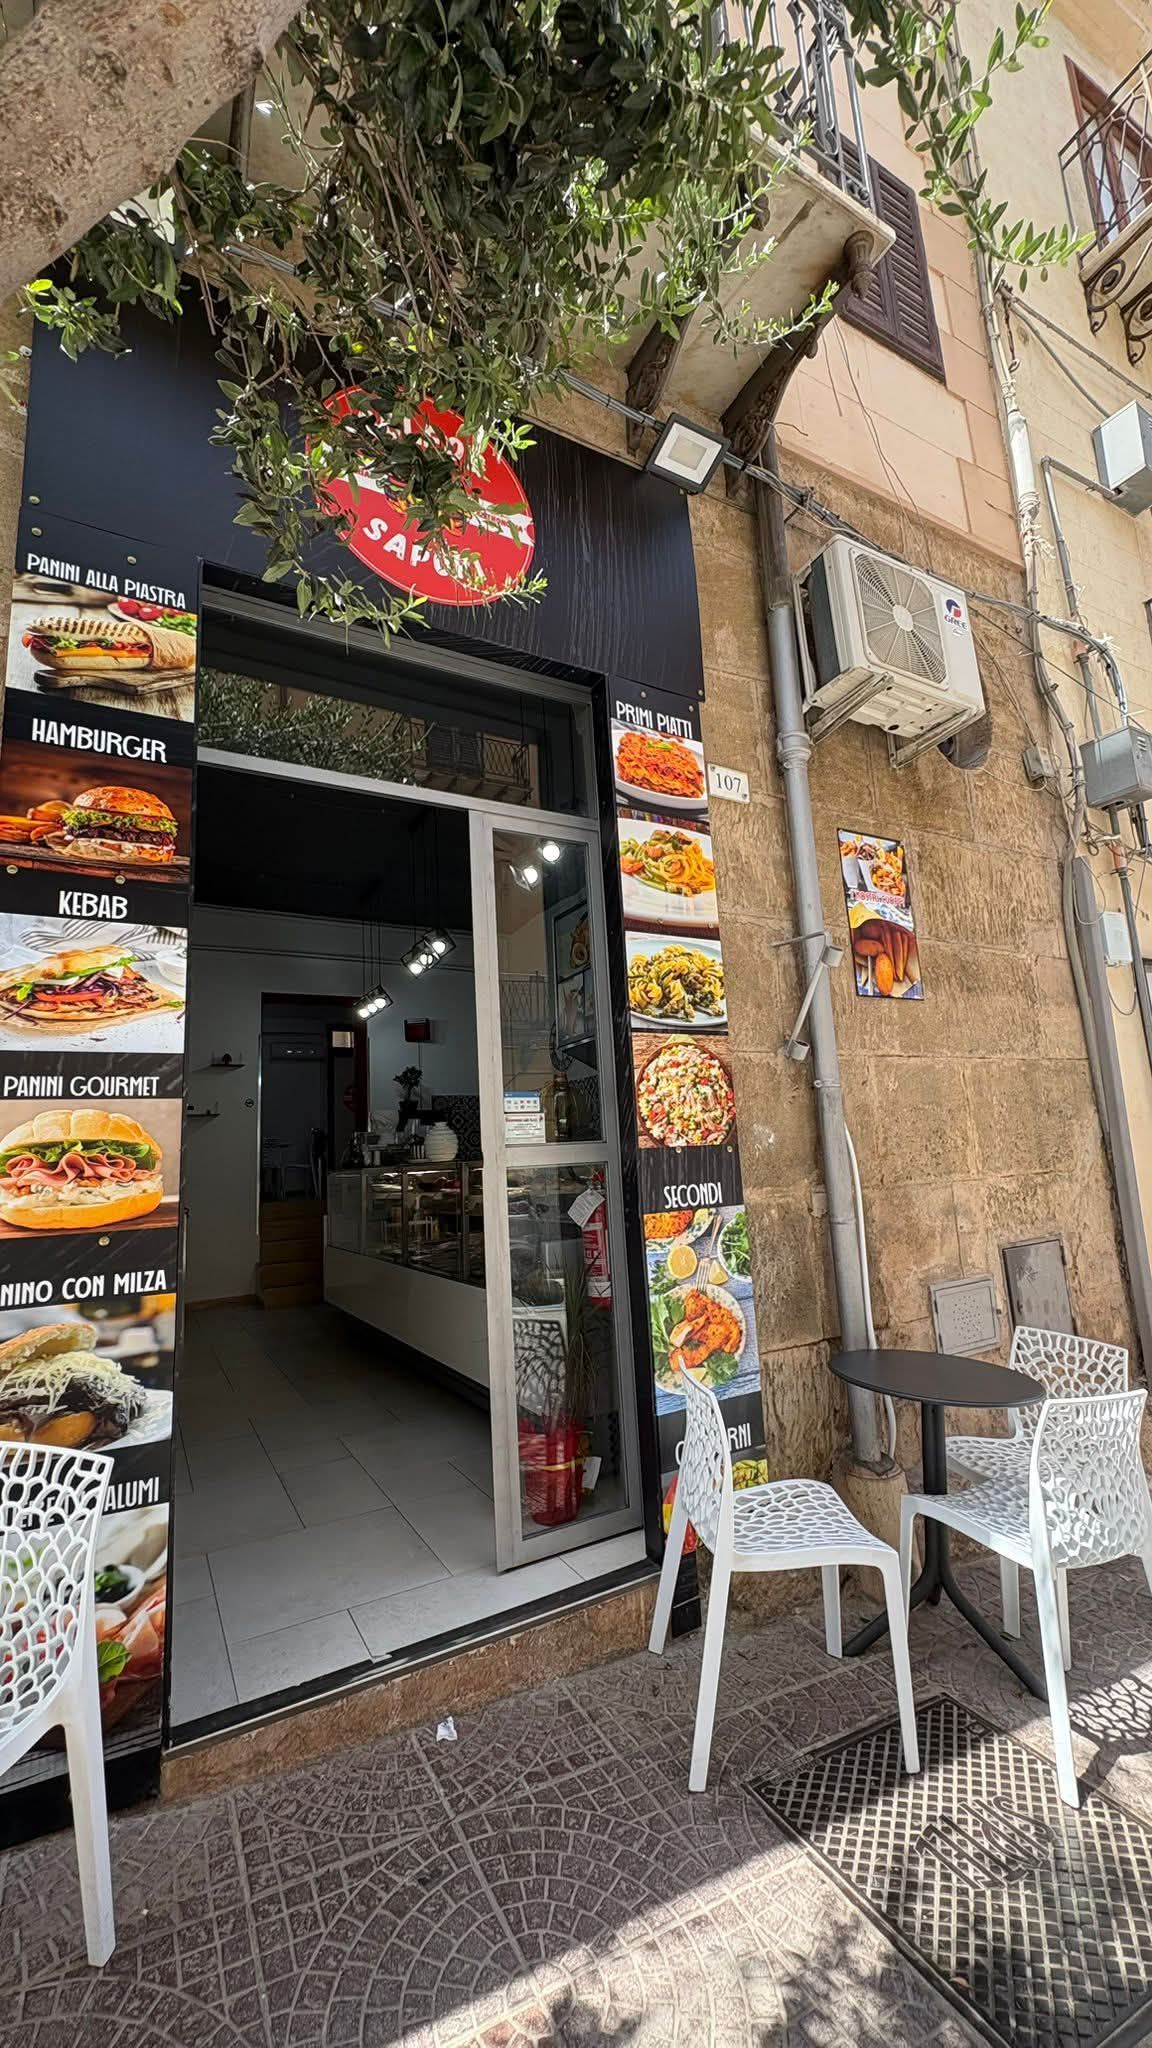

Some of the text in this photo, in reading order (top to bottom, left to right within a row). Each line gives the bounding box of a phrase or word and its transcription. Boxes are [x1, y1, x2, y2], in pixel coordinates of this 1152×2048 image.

[27, 553, 186, 609] PANINI ALLA PIASTRA
[616, 701, 692, 739] PRIMI PIATTI
[31, 718, 168, 763] HAMBURGER
[716, 773, 741, 793] 107
[58, 890, 128, 920] KEBAB
[3, 1076, 160, 1097] PANINI GOURMET
[663, 1182, 723, 1209] SECONDI
[0, 1270, 167, 1306] NINO CON MILZA
[103, 1476, 159, 1512] ALUMI
